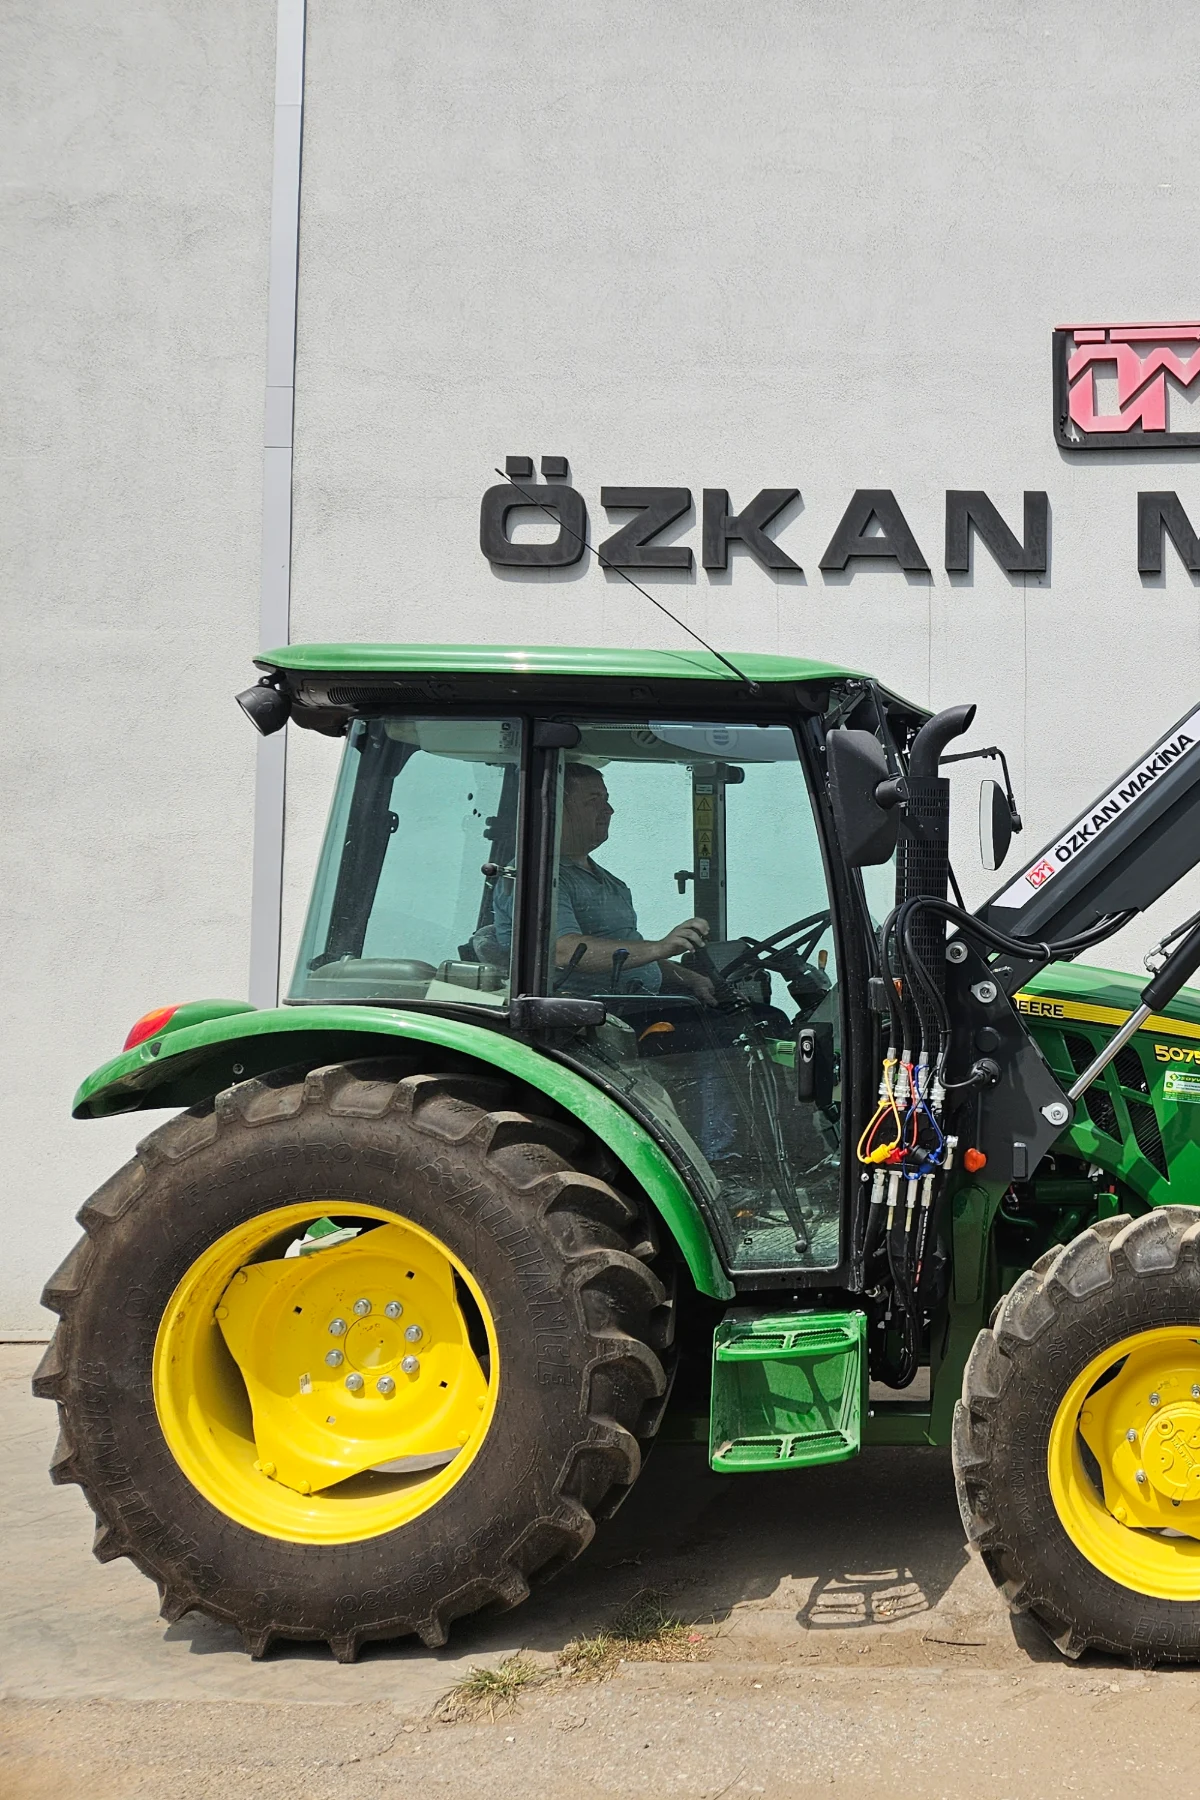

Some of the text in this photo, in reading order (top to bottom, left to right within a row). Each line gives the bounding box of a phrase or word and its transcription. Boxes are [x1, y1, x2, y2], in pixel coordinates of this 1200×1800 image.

[479, 455, 1051, 574] ÖZKAN
[1053, 734, 1196, 863] ÖZKAN MAKİNA
[444, 1184, 572, 1386] ALLIANCE
